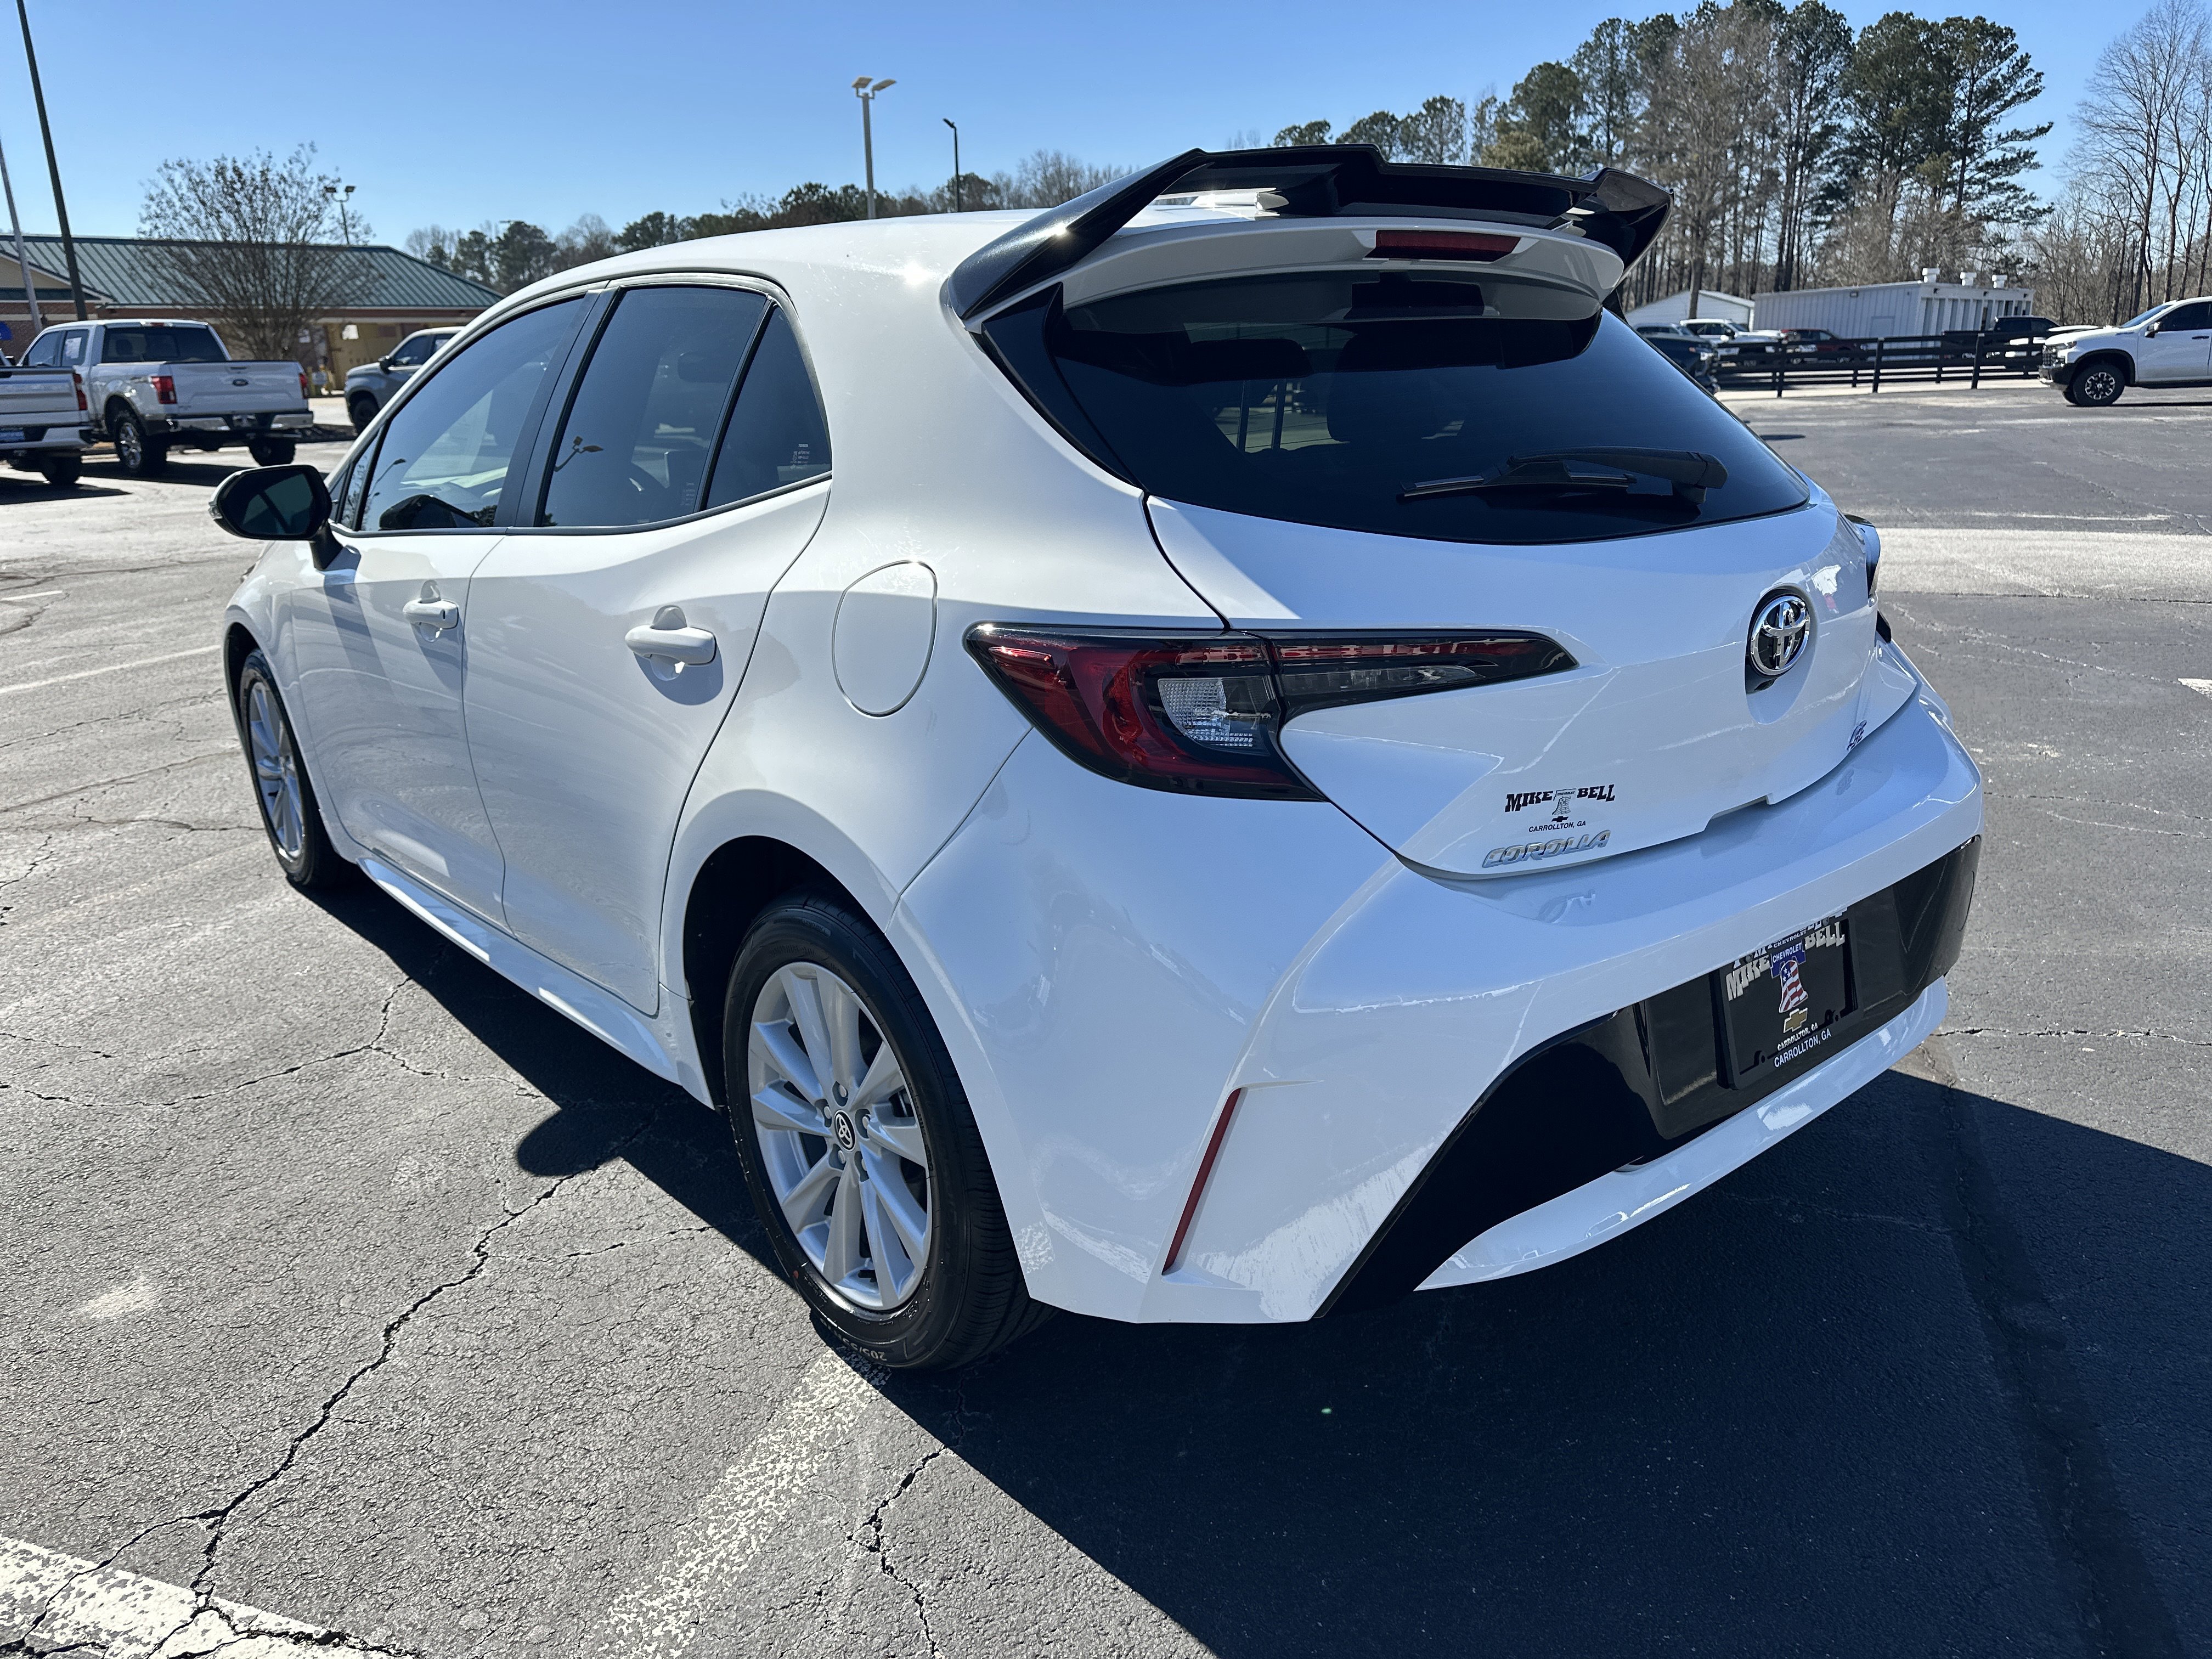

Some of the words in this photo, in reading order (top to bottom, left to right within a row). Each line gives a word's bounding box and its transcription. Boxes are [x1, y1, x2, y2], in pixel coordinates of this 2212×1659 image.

[1504, 791, 1553, 812] MIKE
[1576, 784, 1616, 802] BELL
[1528, 822, 1575, 832] CARROLLTON,
[1481, 830, 1611, 868] COROLLA
[1725, 954, 1770, 1001] MIKE
[1804, 921, 1846, 950] BELL
[1772, 942, 1803, 963] CHEVROLET
[1811, 1022, 1819, 1031] GA
[1774, 1035, 1821, 1068] CARROLLTON,
[1821, 1028, 1831, 1041] GA
